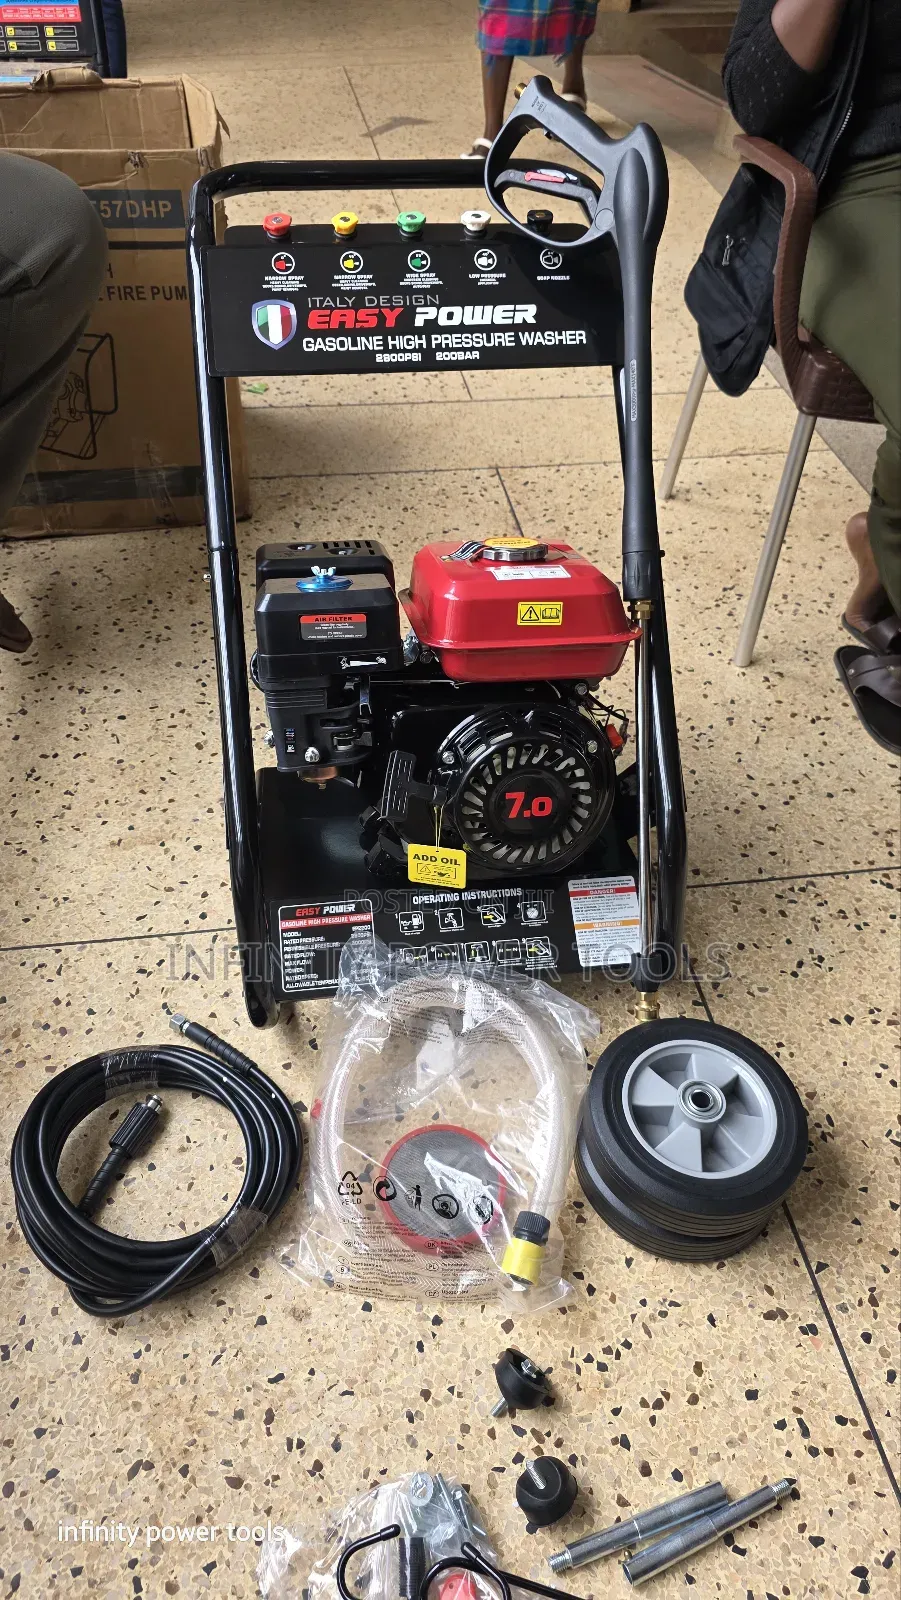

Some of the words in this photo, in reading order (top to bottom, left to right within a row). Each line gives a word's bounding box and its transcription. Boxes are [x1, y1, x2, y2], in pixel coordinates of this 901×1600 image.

[91, 200, 172, 218] 57DHP
[106, 285, 147, 301] FIRE
[150, 285, 188, 301] PUM
[307, 296, 356, 308] ITALY
[365, 294, 440, 307] DESIGN
[307, 307, 404, 329] EASY
[414, 304, 537, 327] POWER
[302, 336, 383, 352] GASOLINE
[388, 335, 427, 350] HIGH
[431, 332, 515, 349] PRESSURE
[519, 330, 587, 346] WASHER
[435, 351, 480, 361] 200BAR
[504, 791, 553, 819] 7.0
[412, 853, 438, 862] ADD
[440, 857, 461, 866] OIL
[412, 892, 460, 905] OPERATING
[461, 887, 523, 901] INSTRUCTIONS
[295, 906, 321, 917] EASY
[322, 903, 356, 915] POWER
[281, 920, 307, 928] GASOLINE
[308, 918, 321, 926] HIGH
[321, 916, 349, 924] PRESSURE
[348, 914, 371, 922] WASHER
[345, 1182, 356, 1190] 04
